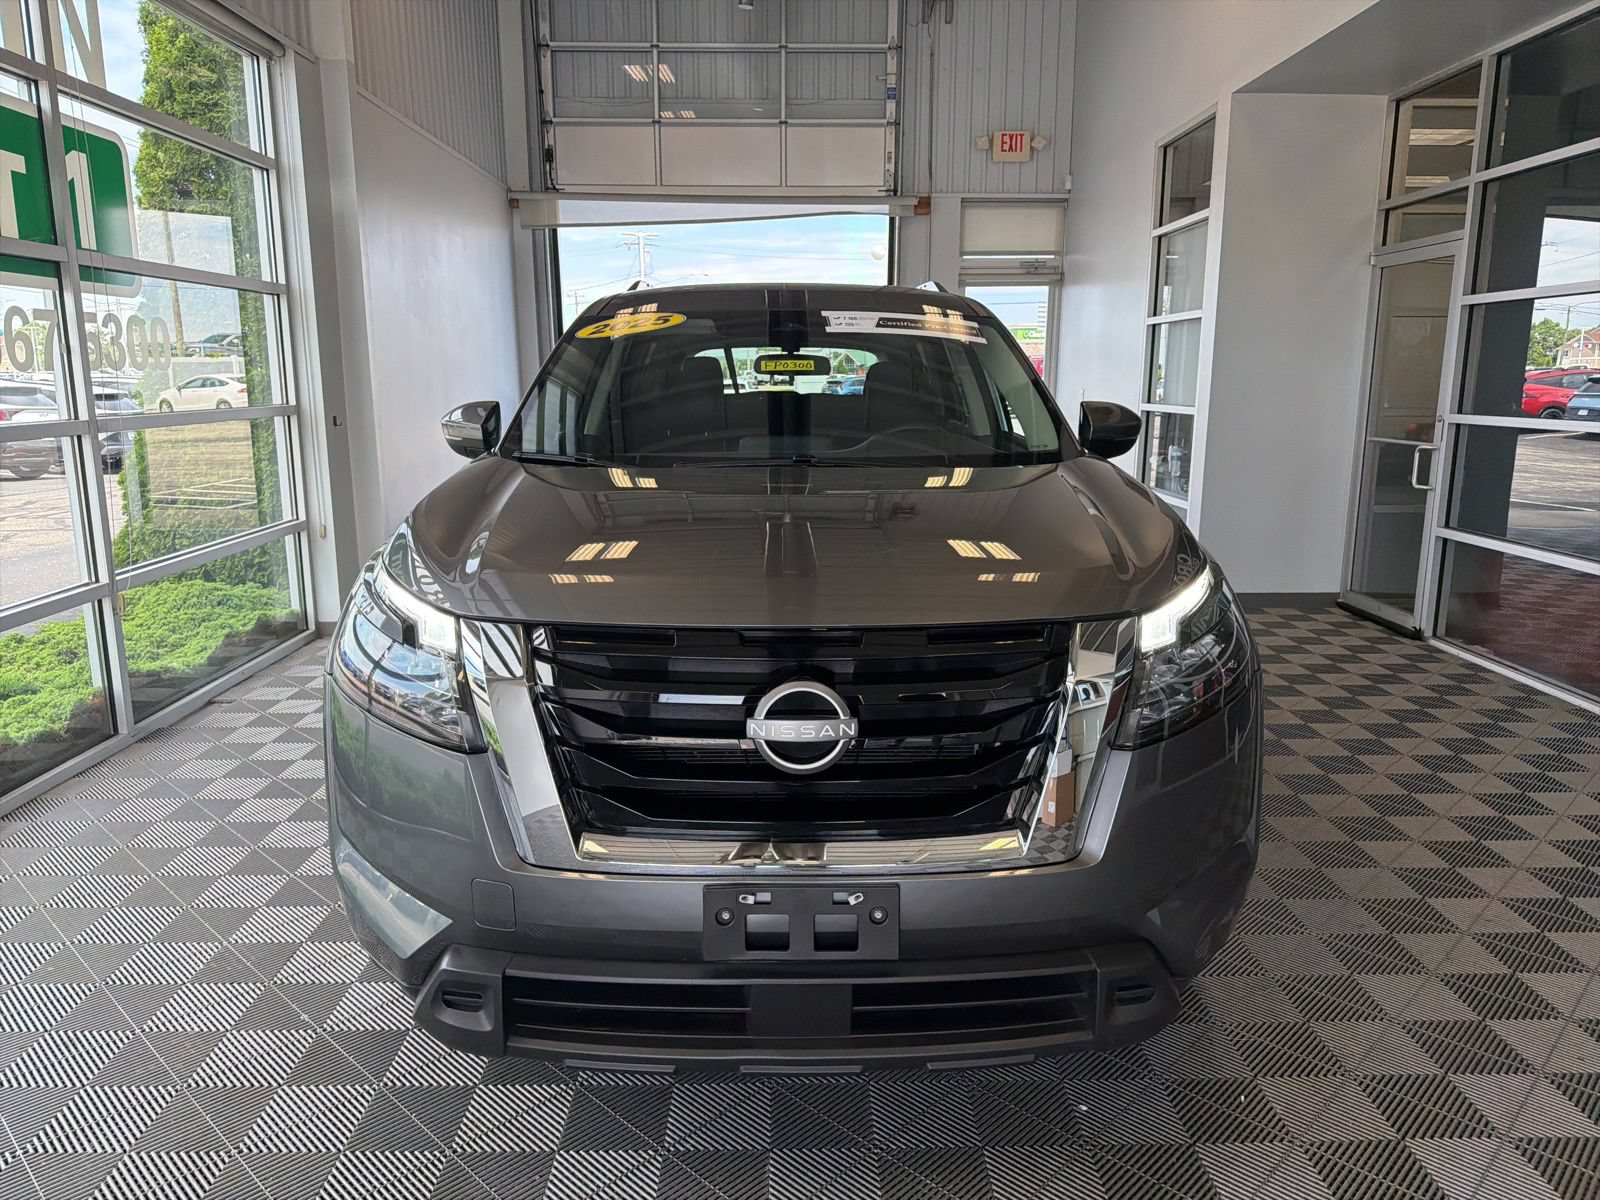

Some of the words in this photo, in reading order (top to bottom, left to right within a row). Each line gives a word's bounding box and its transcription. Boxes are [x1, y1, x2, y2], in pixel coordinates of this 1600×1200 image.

[1000, 132, 1025, 153] EXIT
[586, 314, 674, 337] 2025
[879, 319, 922, 328] Certified
[750, 722, 856, 738] NISSAN
